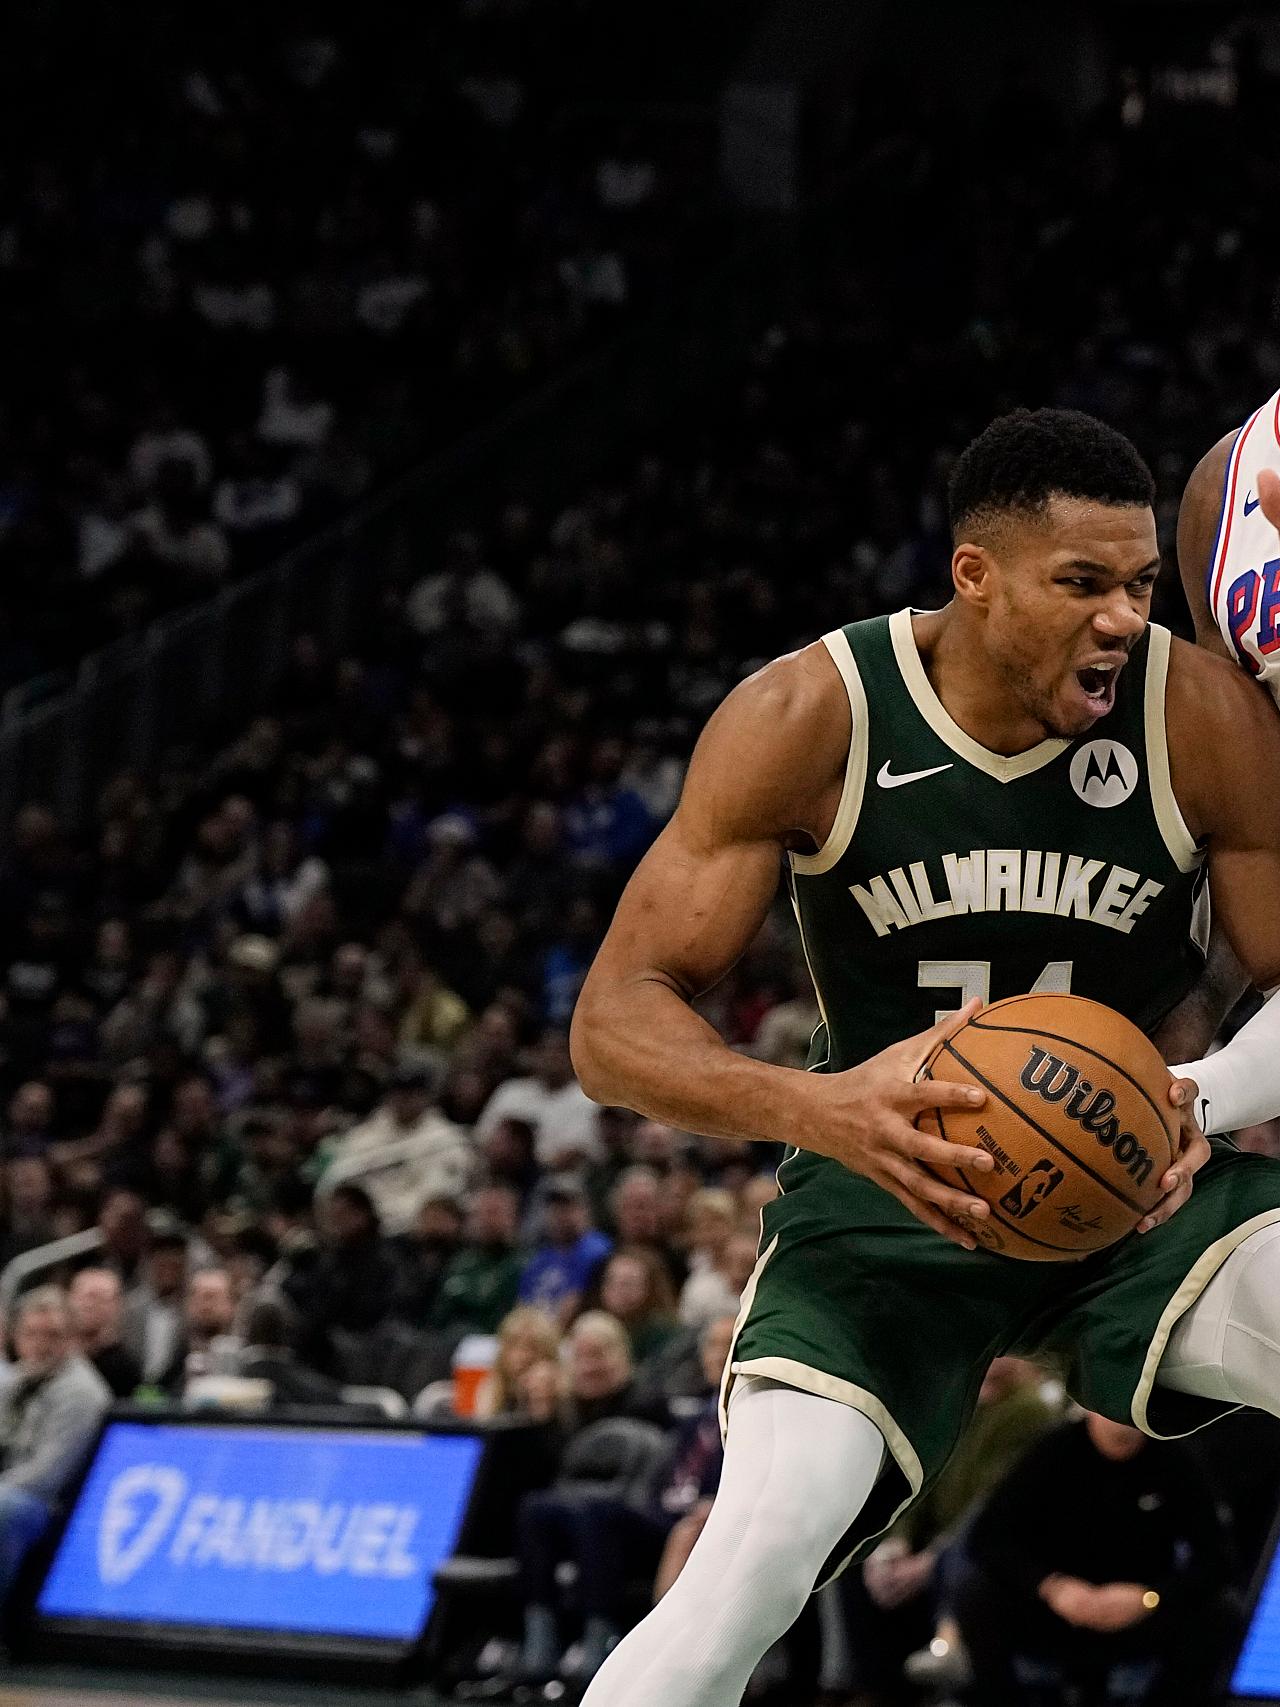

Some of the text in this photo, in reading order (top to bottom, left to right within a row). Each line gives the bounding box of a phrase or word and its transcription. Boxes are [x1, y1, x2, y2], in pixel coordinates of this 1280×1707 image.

[848, 849, 1165, 937] MILWAUKEE
[975, 1124, 998, 1152] OFFICIAL
[992, 1146, 1010, 1166] GAME
[1004, 1160, 1021, 1177] BALL
[1019, 1044, 1155, 1187] Wilson
[171, 1496, 421, 1579] FANDUEL
